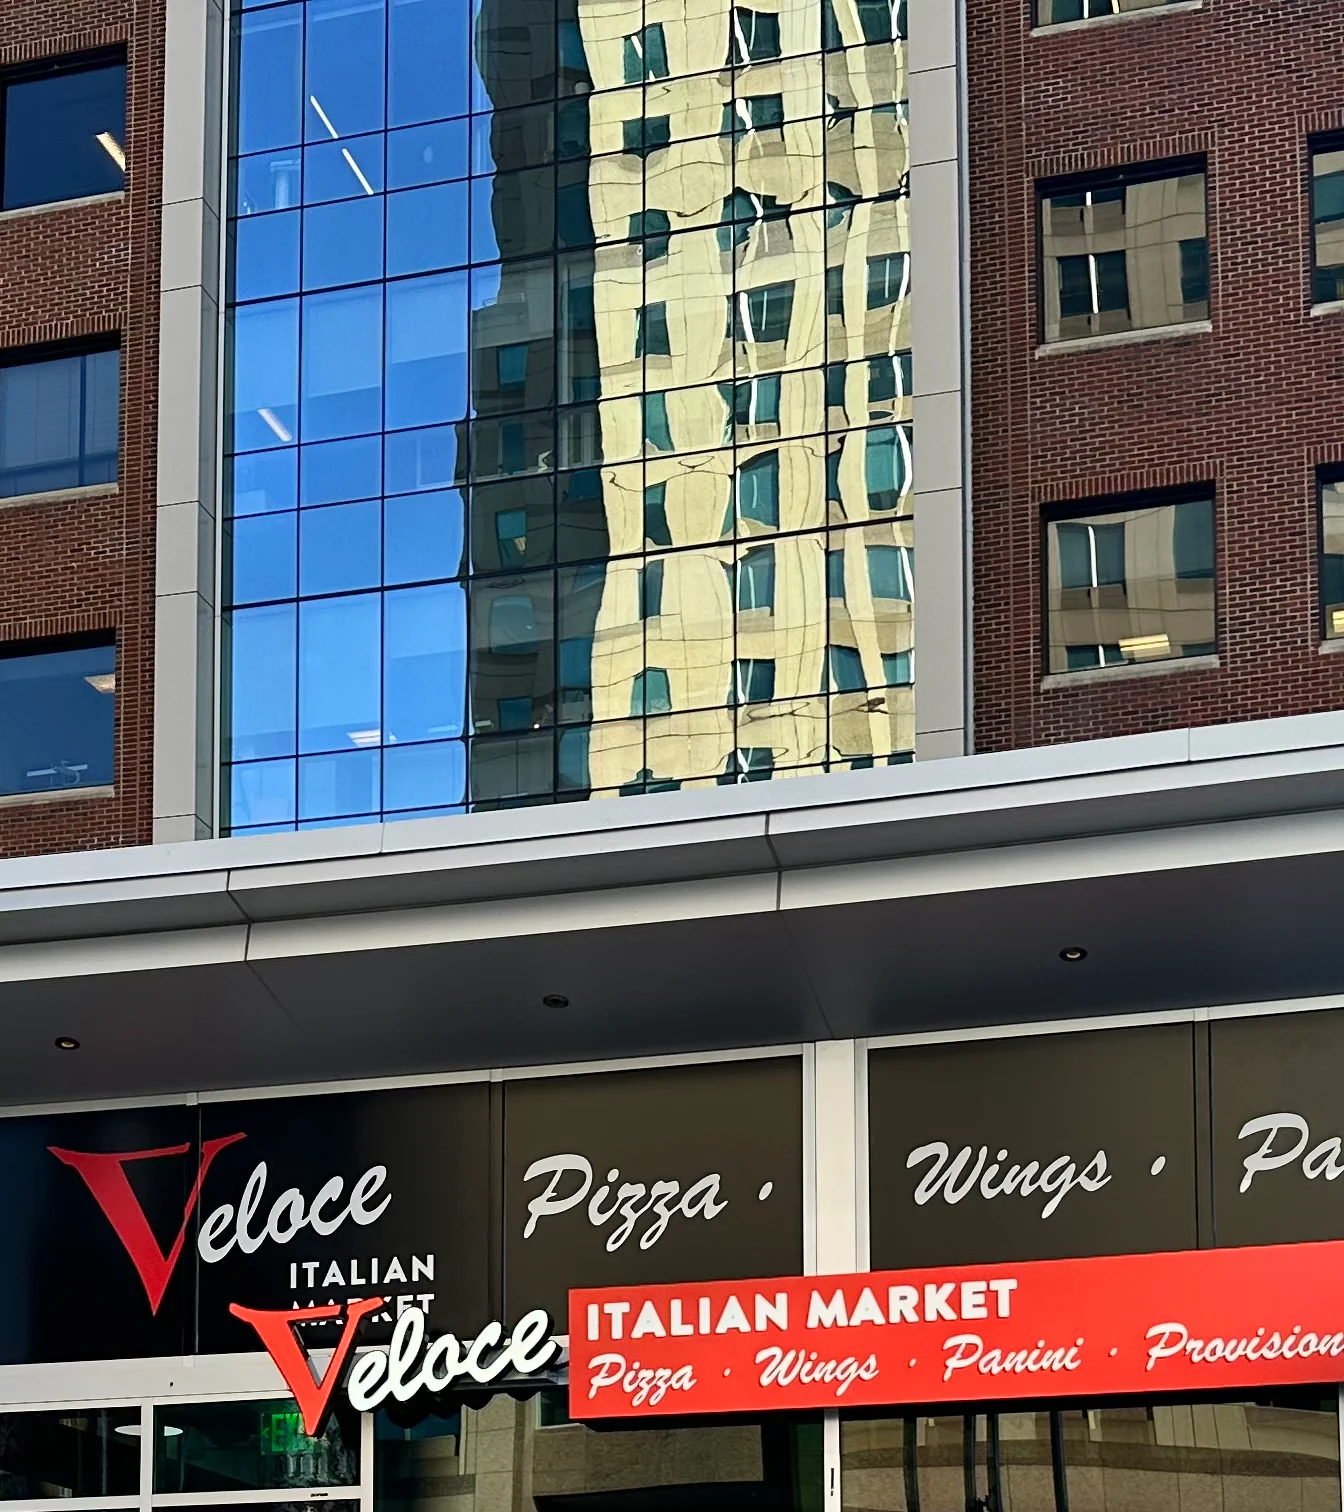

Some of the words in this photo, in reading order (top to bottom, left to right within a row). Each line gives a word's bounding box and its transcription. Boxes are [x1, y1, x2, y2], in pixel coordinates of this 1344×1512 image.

[46, 1132, 392, 1316] Veloce
[523, 1153, 728, 1252] Pizza
[906, 1141, 1112, 1218] Wings
[290, 1254, 434, 1288] ITALIAN
[587, 1291, 789, 1342] ITALIAN
[806, 1277, 1019, 1329] MARKET
[229, 1297, 556, 1437] Veloce
[587, 1353, 697, 1408] Pizza
[755, 1346, 880, 1397] Wings
[942, 1332, 1084, 1381] Panini
